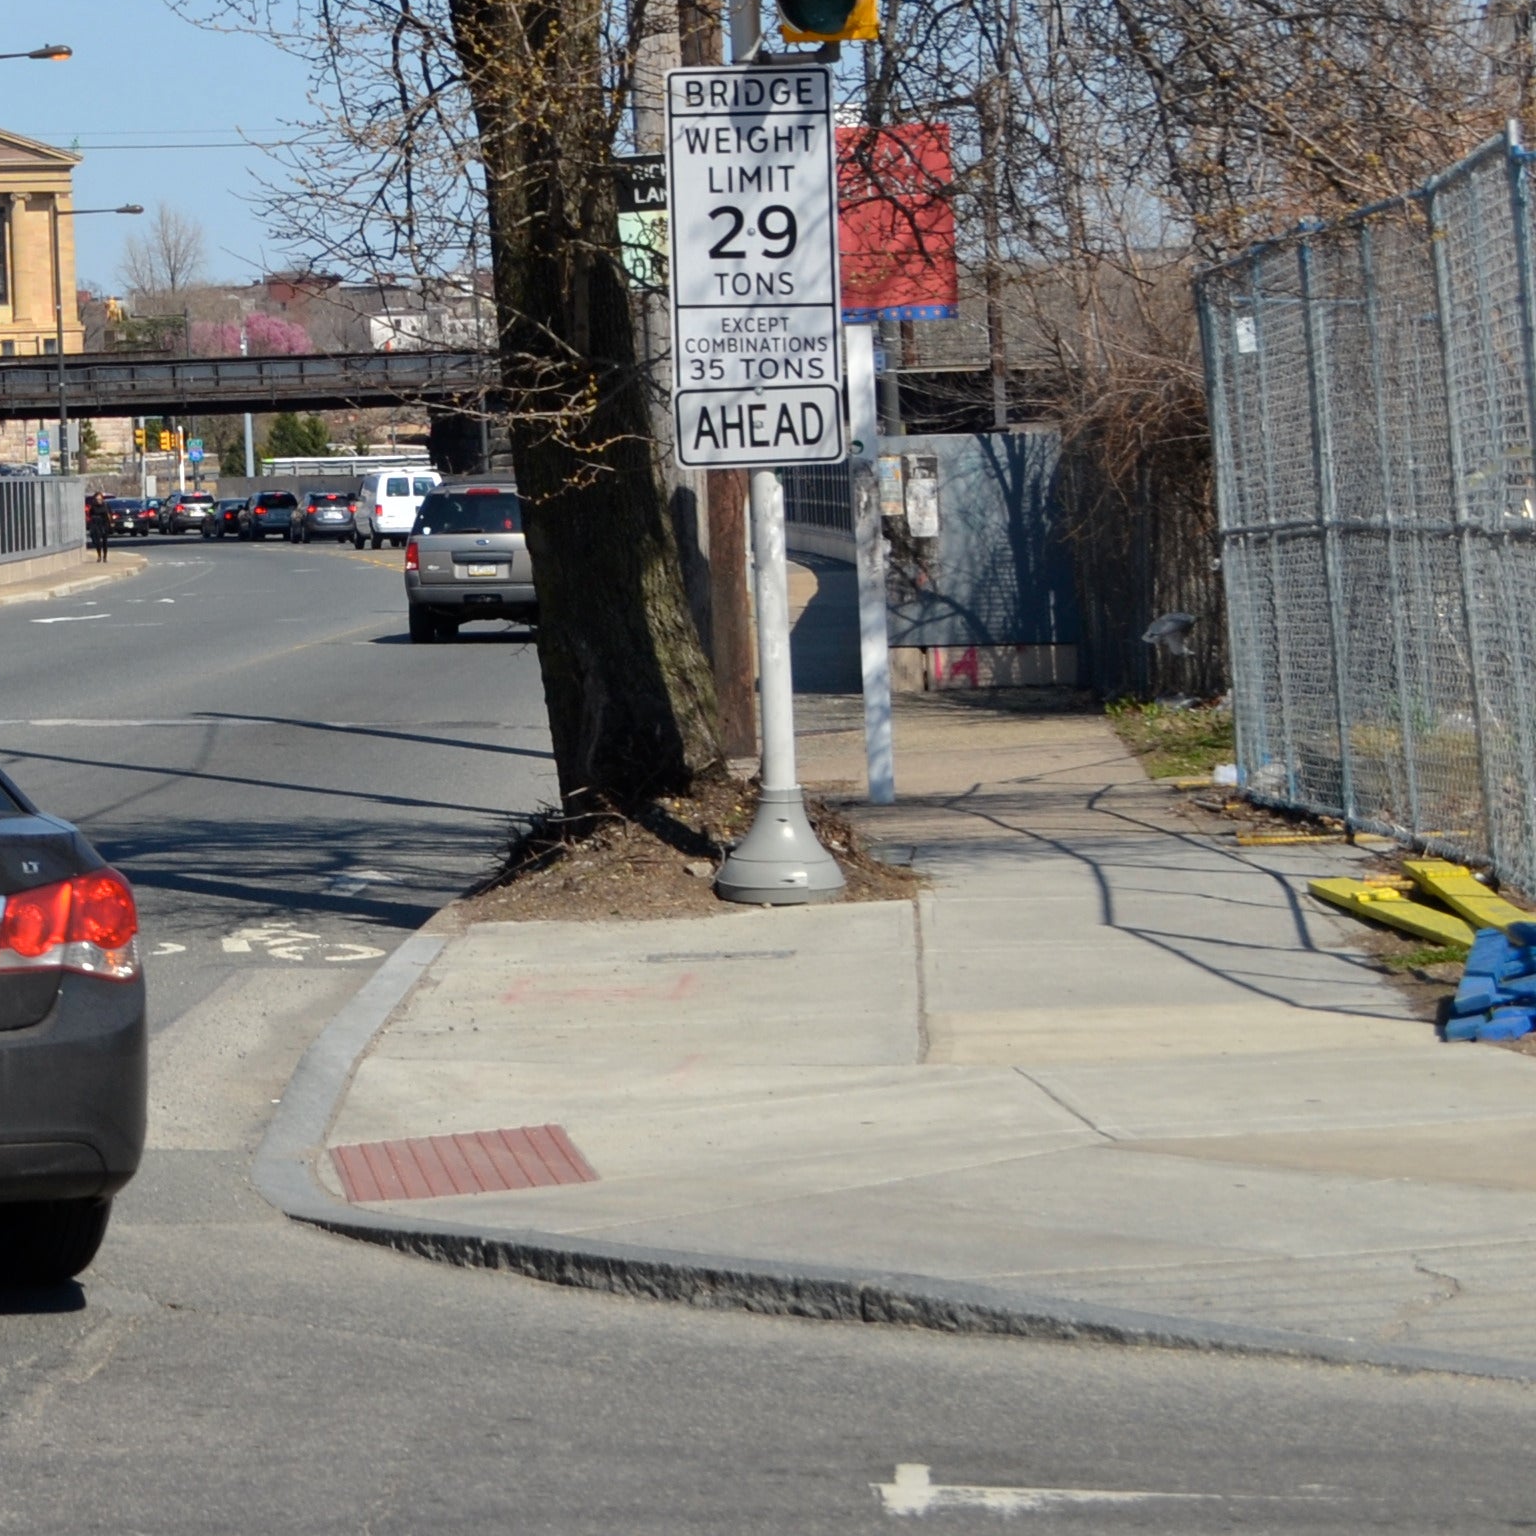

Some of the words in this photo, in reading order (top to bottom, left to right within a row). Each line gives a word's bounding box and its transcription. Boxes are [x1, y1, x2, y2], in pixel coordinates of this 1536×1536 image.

[685, 77, 814, 107] BRIDGE
[685, 125, 816, 154] WEIGHT
[708, 165, 795, 194] LIMIT
[708, 204, 798, 260] 29
[714, 271, 794, 296] TONS
[721, 317, 790, 333] EXCEPT
[685, 336, 828, 354] COMBINATIONS
[690, 358, 726, 381] 35
[739, 357, 825, 380] TONS
[693, 401, 824, 450] AHEAD
